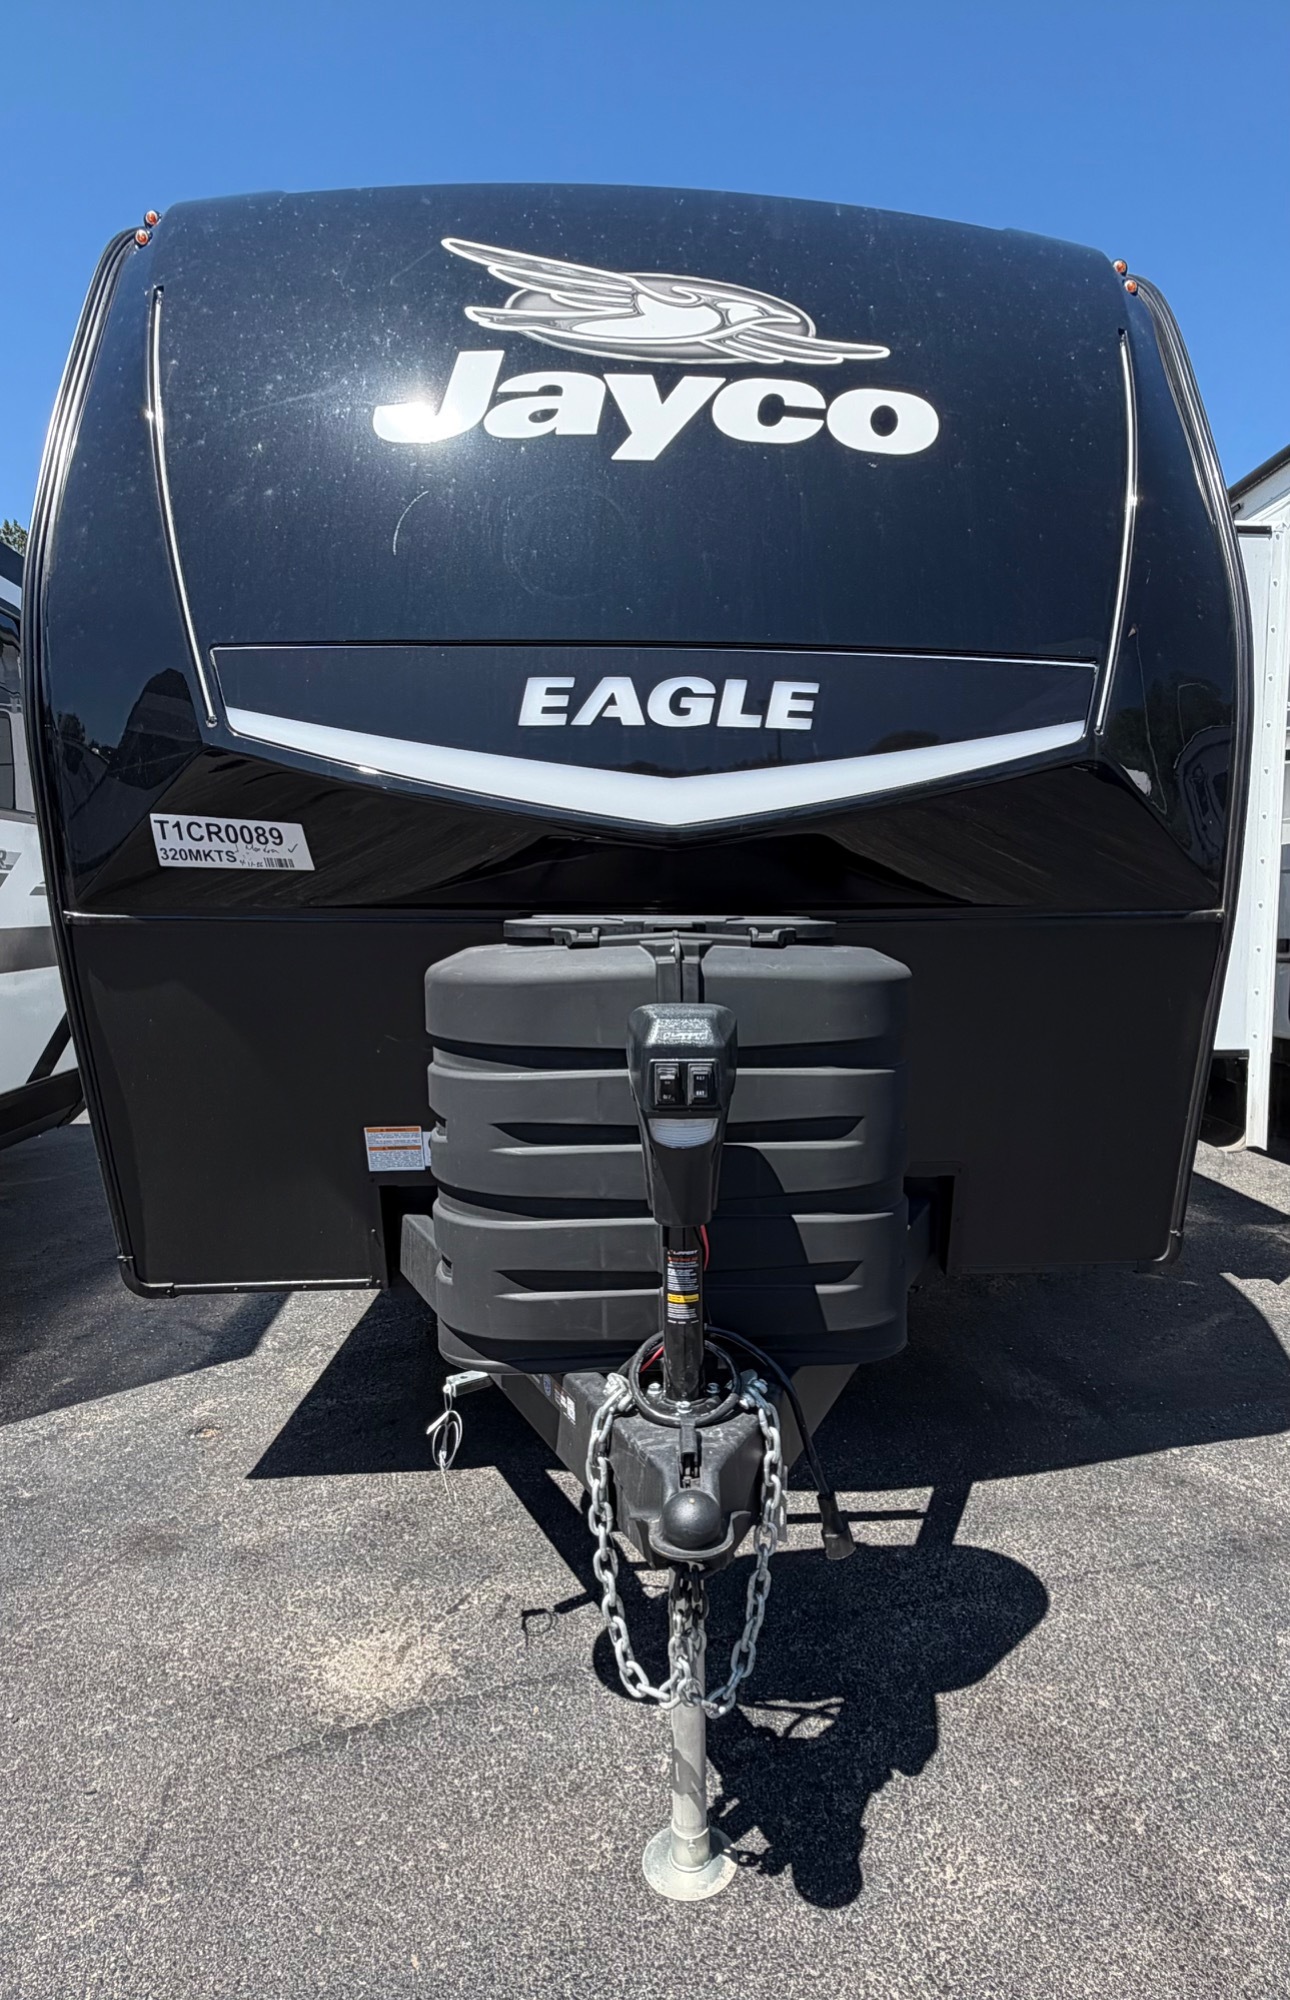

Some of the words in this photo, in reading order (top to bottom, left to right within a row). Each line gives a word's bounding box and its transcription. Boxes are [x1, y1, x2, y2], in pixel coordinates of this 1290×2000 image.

[372, 350, 940, 461] Jayco
[517, 676, 820, 731] EAGLE
[153, 819, 284, 846] T1CR0089
[159, 847, 237, 863] 320MKTS
